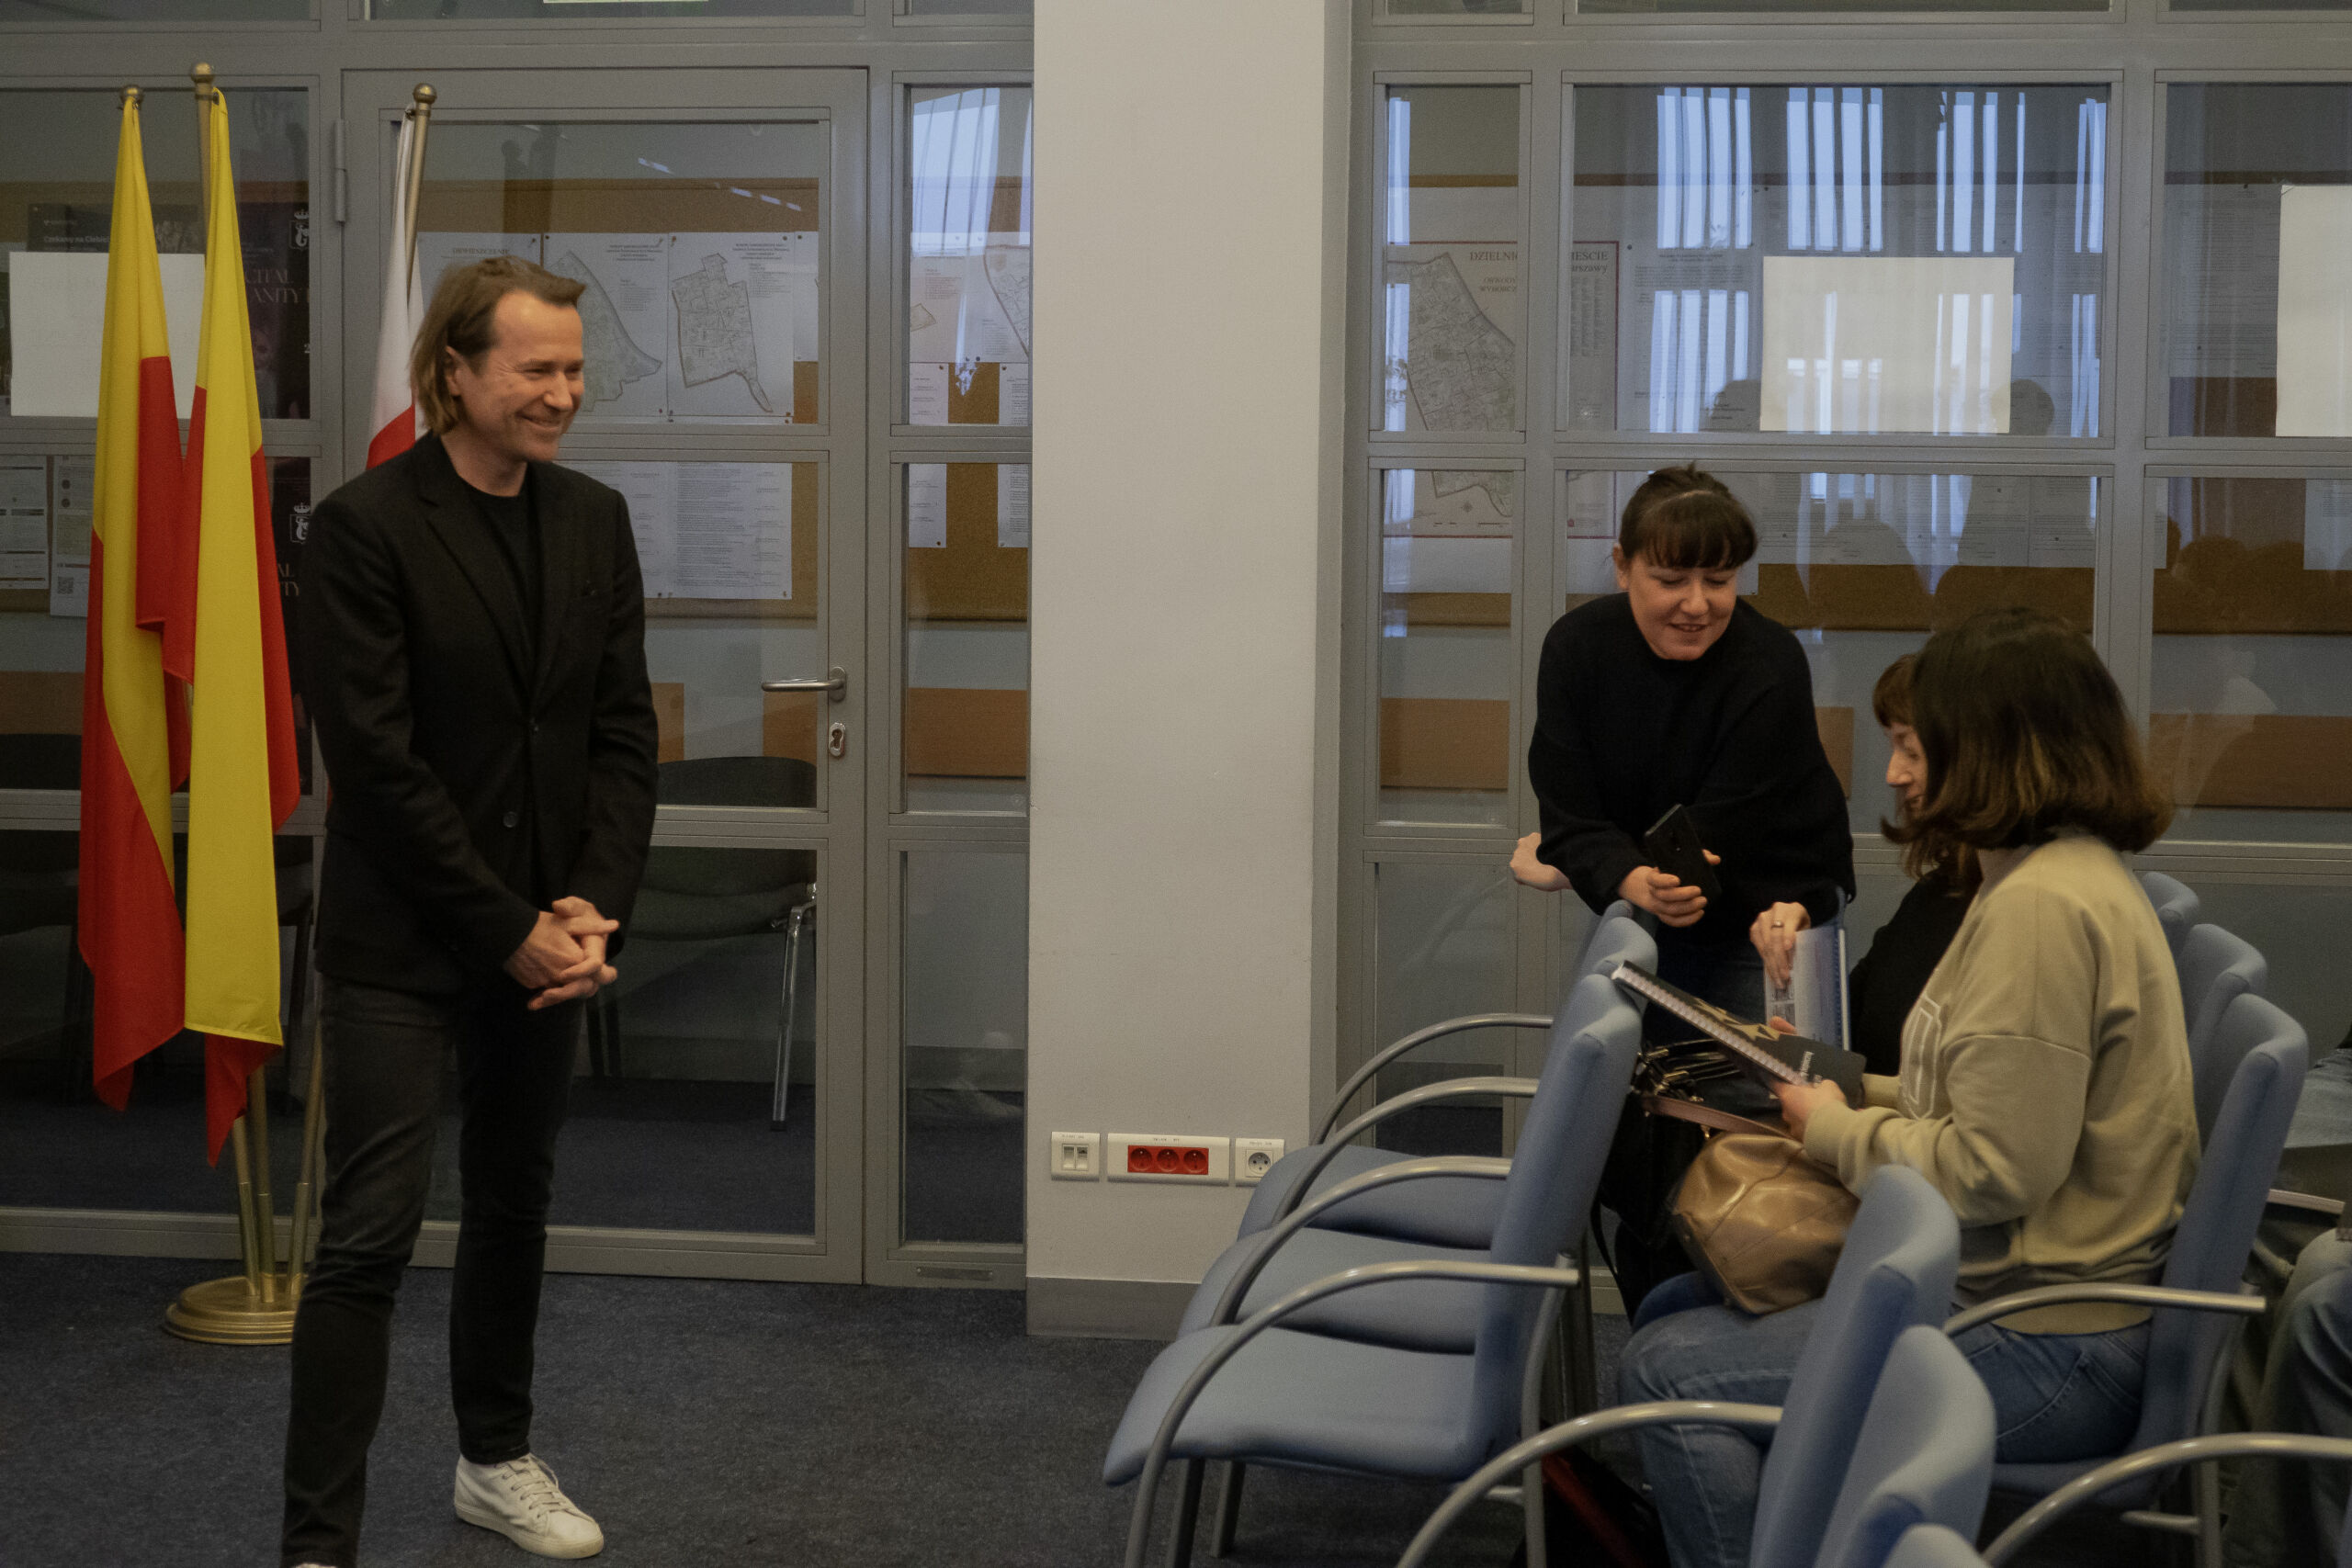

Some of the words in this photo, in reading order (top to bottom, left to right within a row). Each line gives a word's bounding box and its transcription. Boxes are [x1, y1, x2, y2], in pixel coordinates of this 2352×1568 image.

[1470, 251, 1517, 261] DZIELNI
[1571, 264, 1609, 275] arszawy
[245, 269, 294, 283] CITAL
